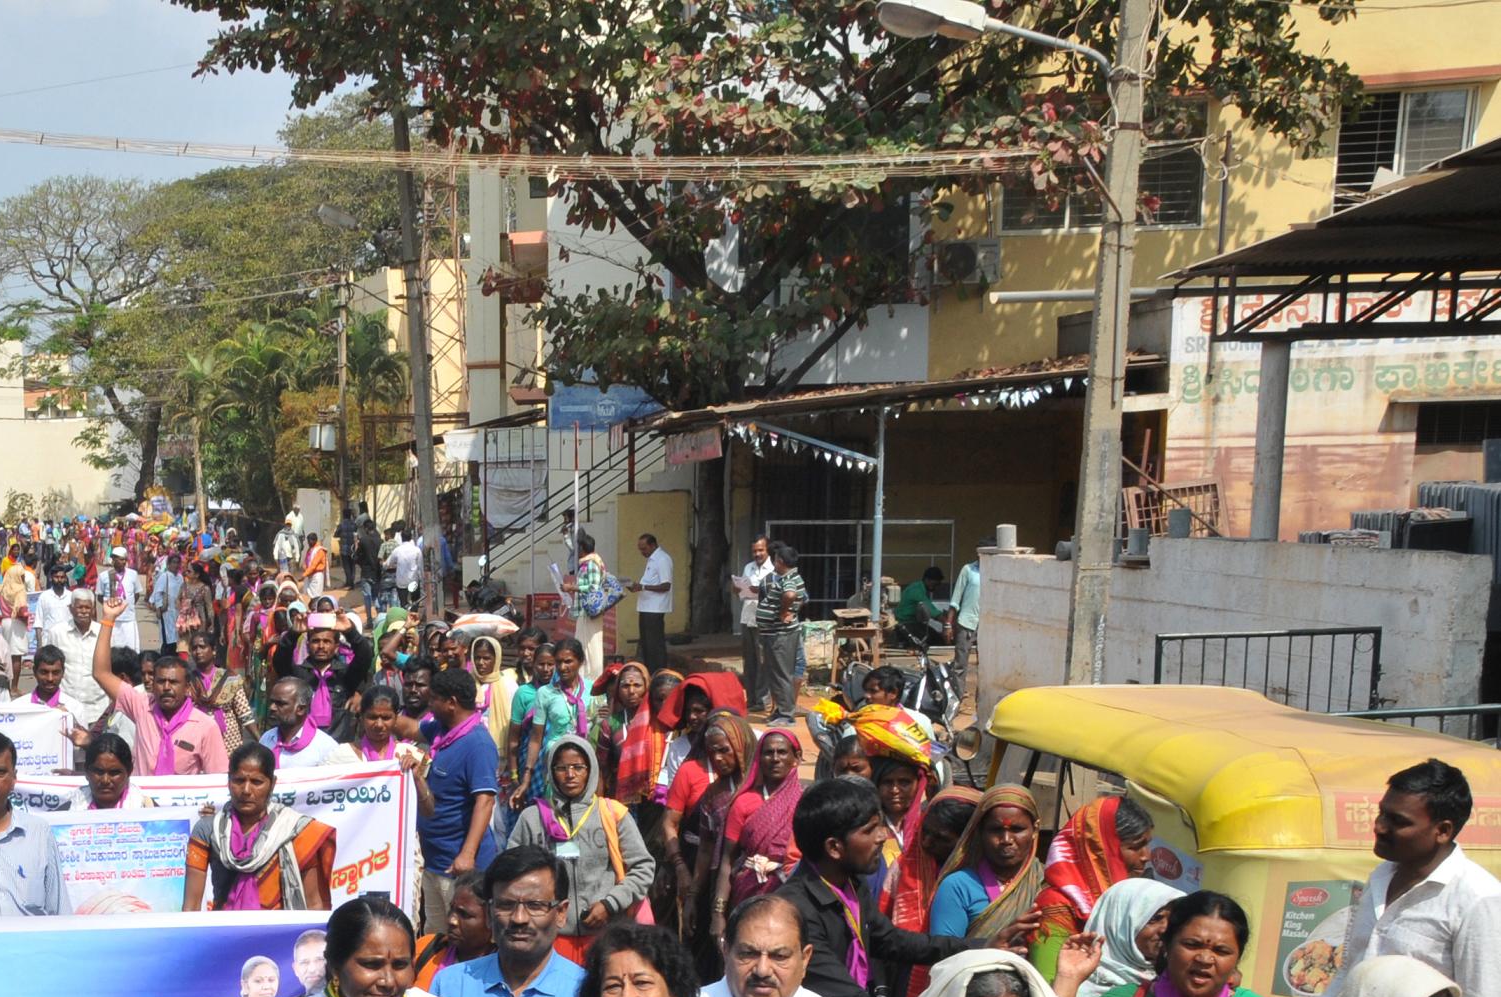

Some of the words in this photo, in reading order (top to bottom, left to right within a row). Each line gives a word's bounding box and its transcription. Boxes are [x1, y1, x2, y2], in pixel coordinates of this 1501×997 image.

[1185, 336, 1207, 354] SR
[1285, 911, 1315, 920] Kitchen
[1283, 920, 1303, 931] King
